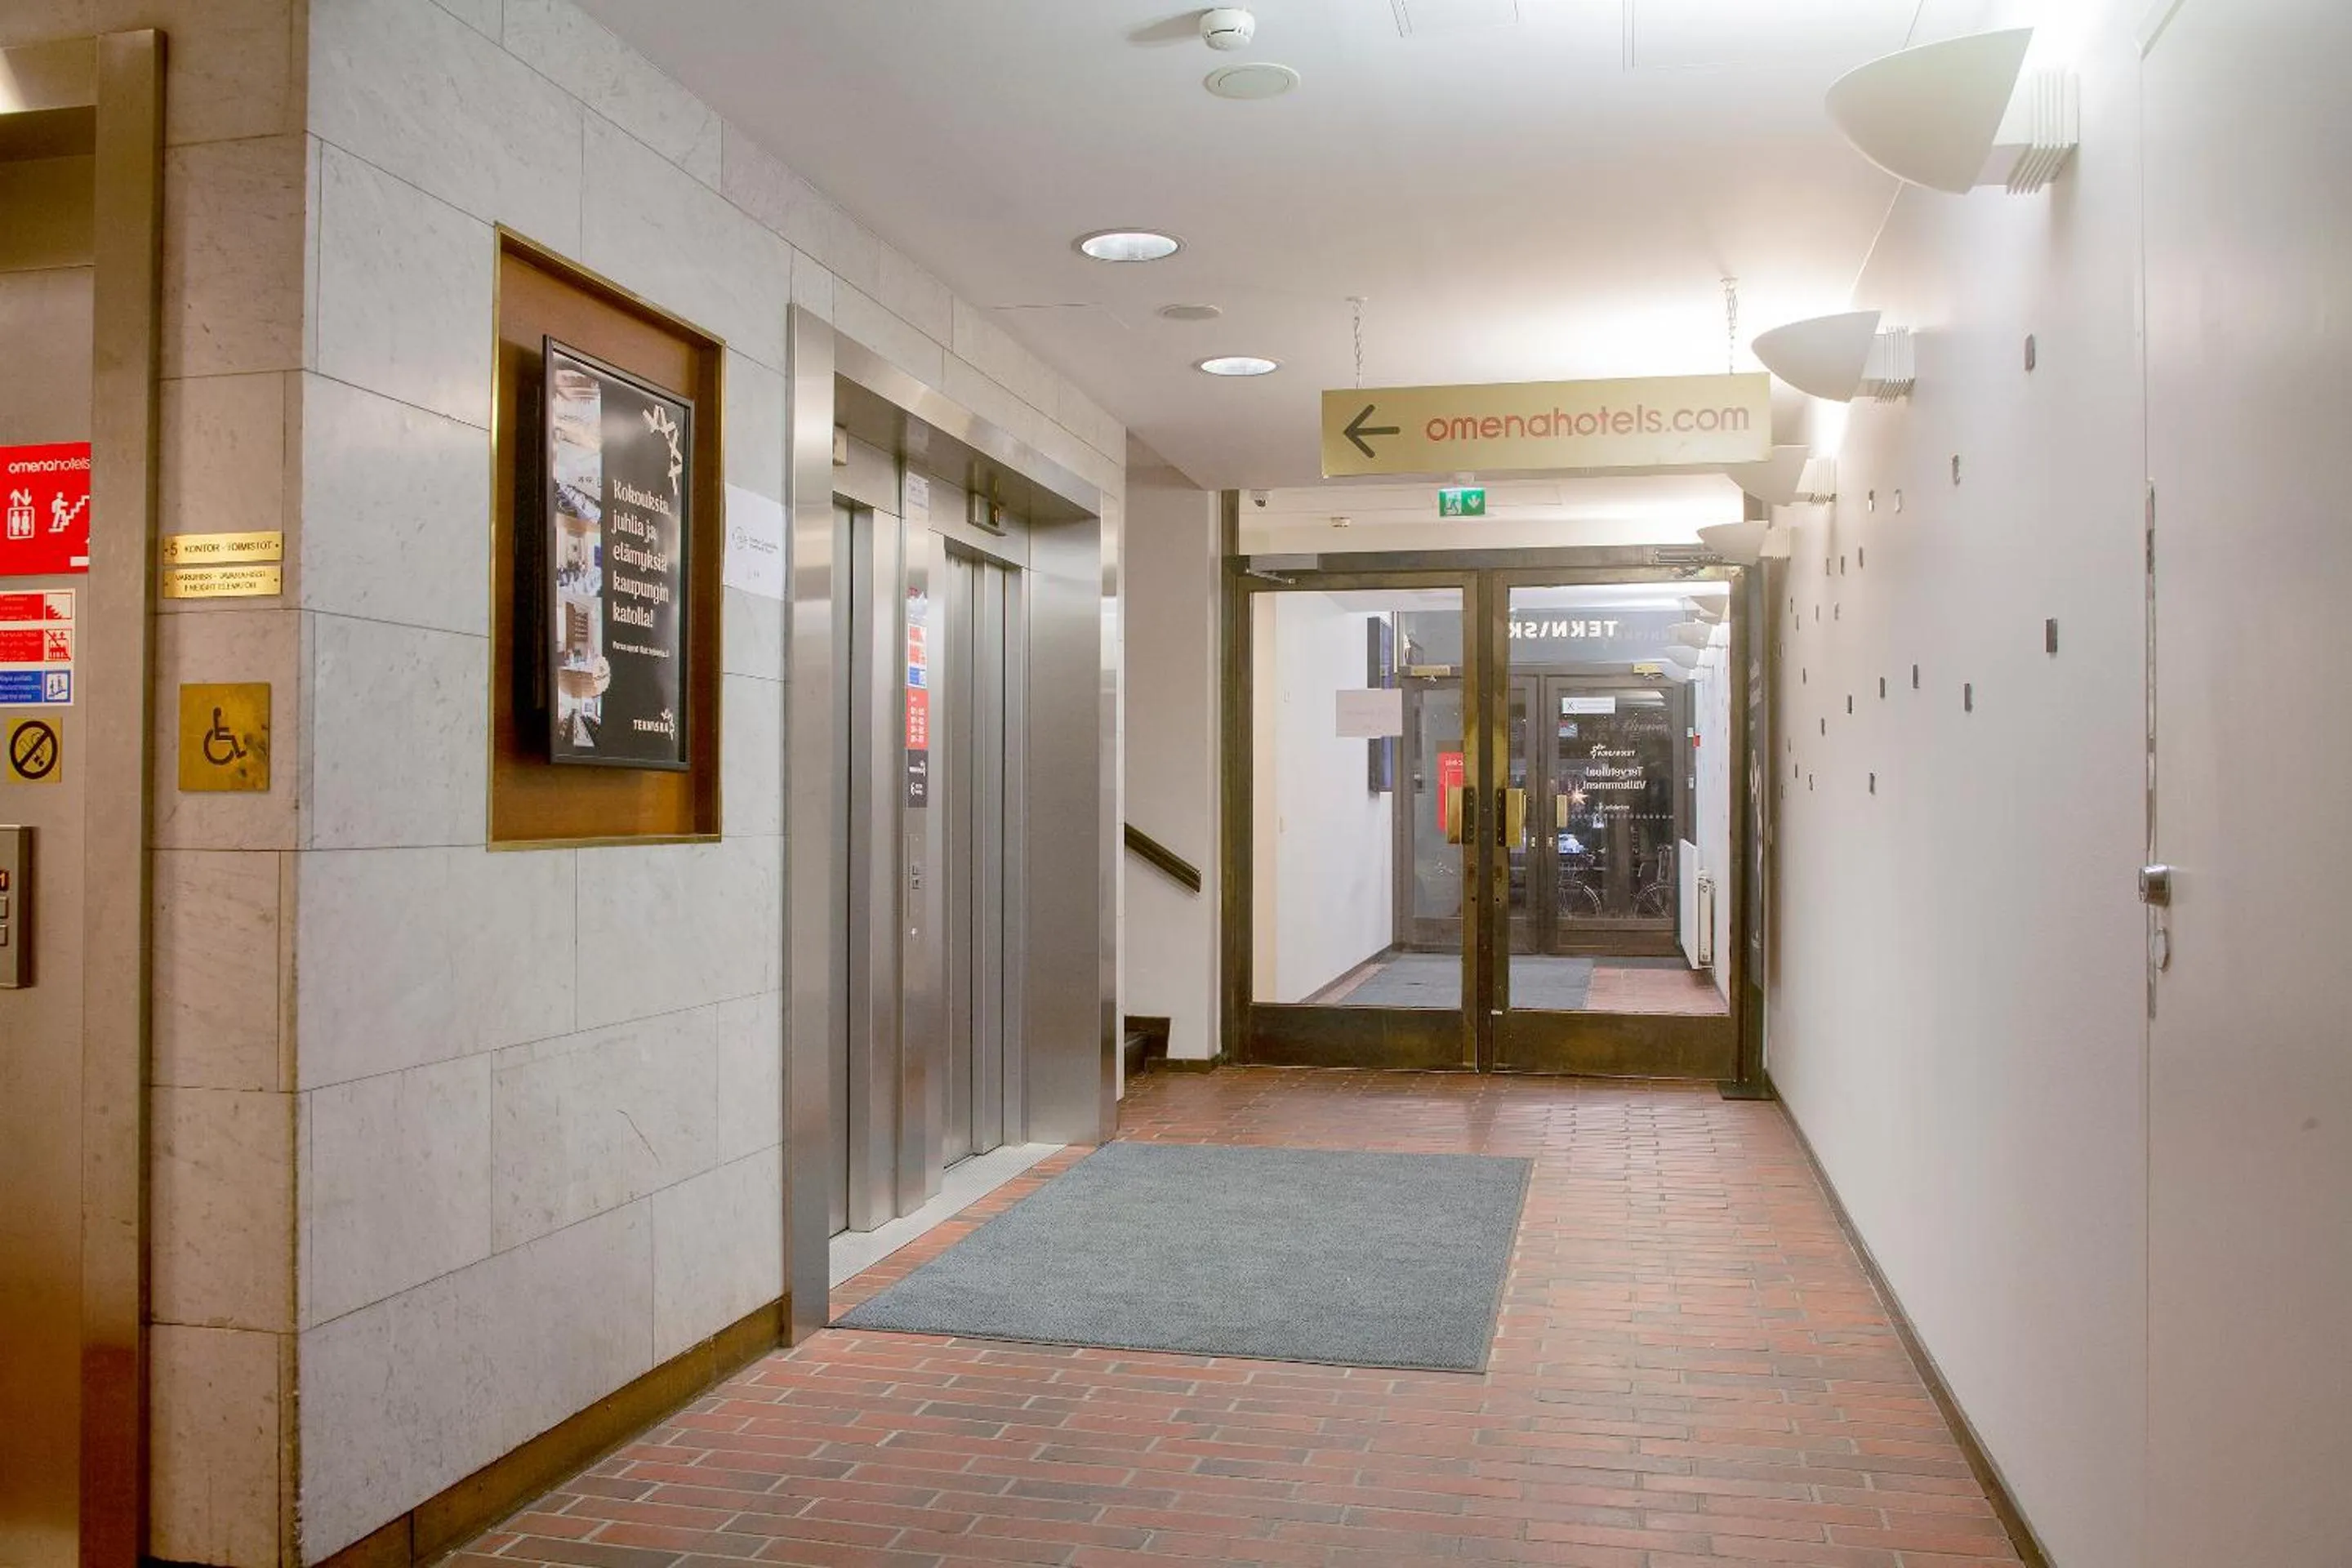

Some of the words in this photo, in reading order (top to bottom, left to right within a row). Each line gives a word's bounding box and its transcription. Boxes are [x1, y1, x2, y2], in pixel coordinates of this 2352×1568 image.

[1426, 404, 1749, 441] omenahotels.com
[8, 457, 91, 474] omenahotels
[611, 510, 644, 537] juhlia
[644, 519, 657, 543] ja
[170, 542, 178, 555] 5
[613, 541, 667, 572] elämyksiä
[612, 570, 669, 604] kaupungin
[612, 601, 653, 628] katolla!
